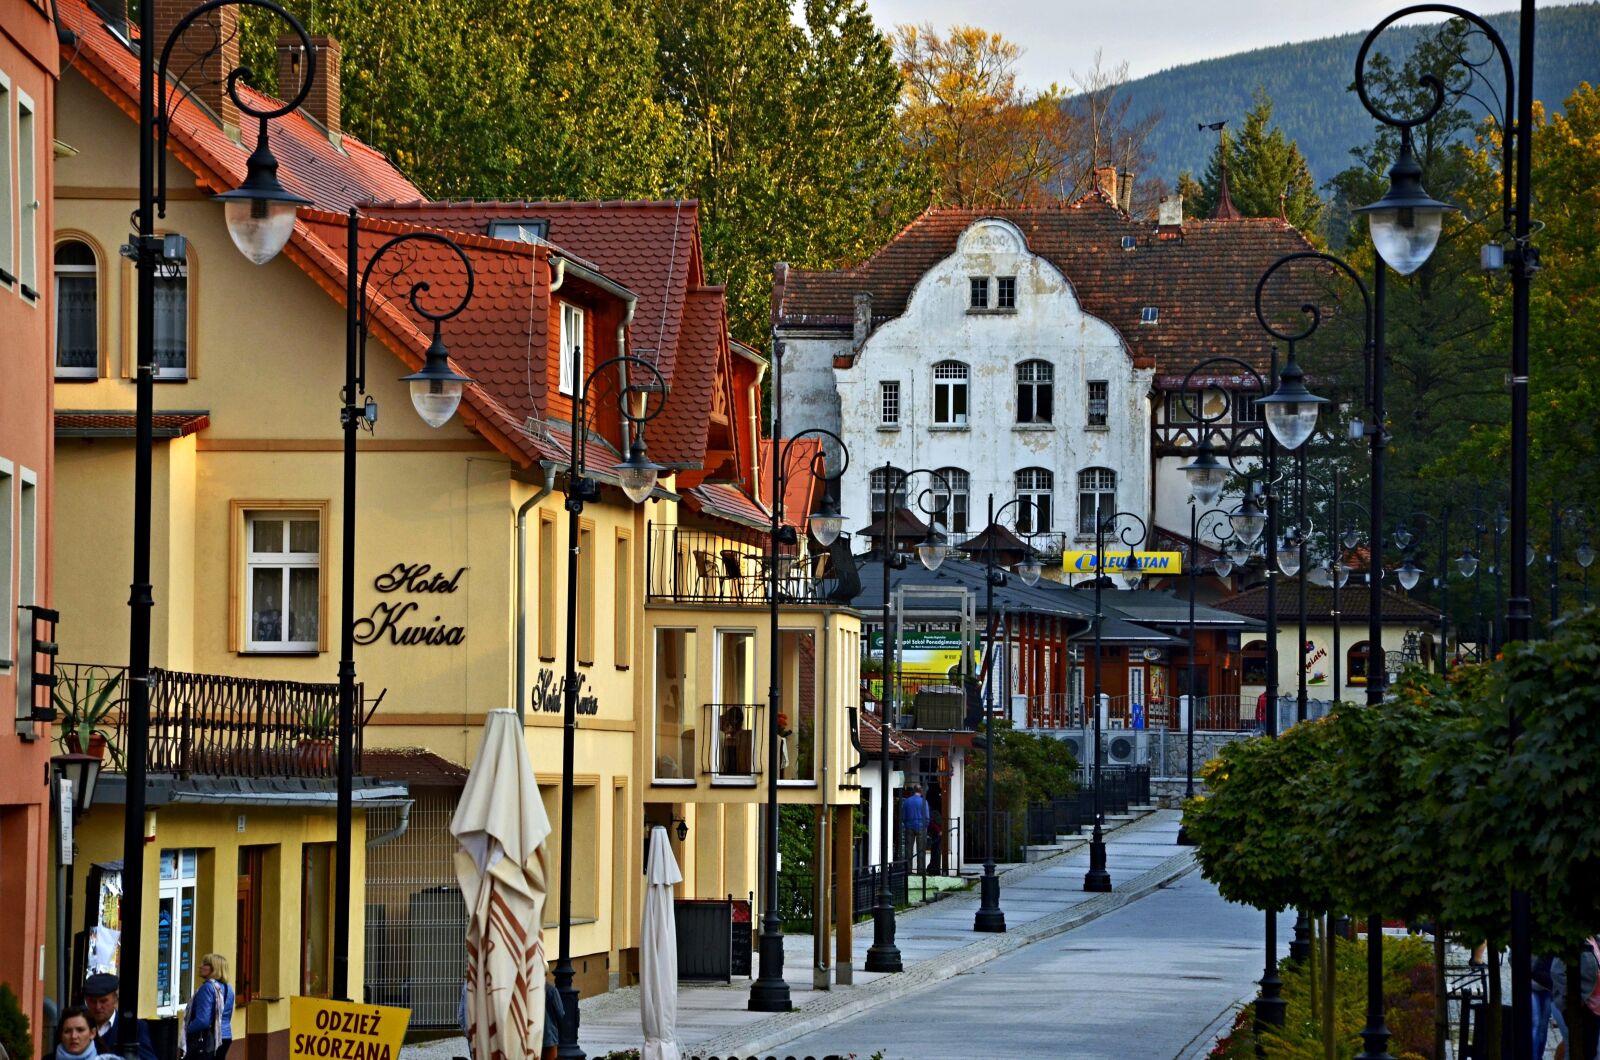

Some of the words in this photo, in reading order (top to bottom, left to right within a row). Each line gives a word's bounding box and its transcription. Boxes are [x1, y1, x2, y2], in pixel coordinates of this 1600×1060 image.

[1103, 557, 1169, 568] LEWATAN
[374, 563, 467, 594] Hotel
[352, 602, 466, 646] Kwisa
[532, 668, 564, 713] Hotel
[315, 1009, 382, 1036] ODZIEŻ
[294, 1031, 391, 1060] SKÓRZANA
